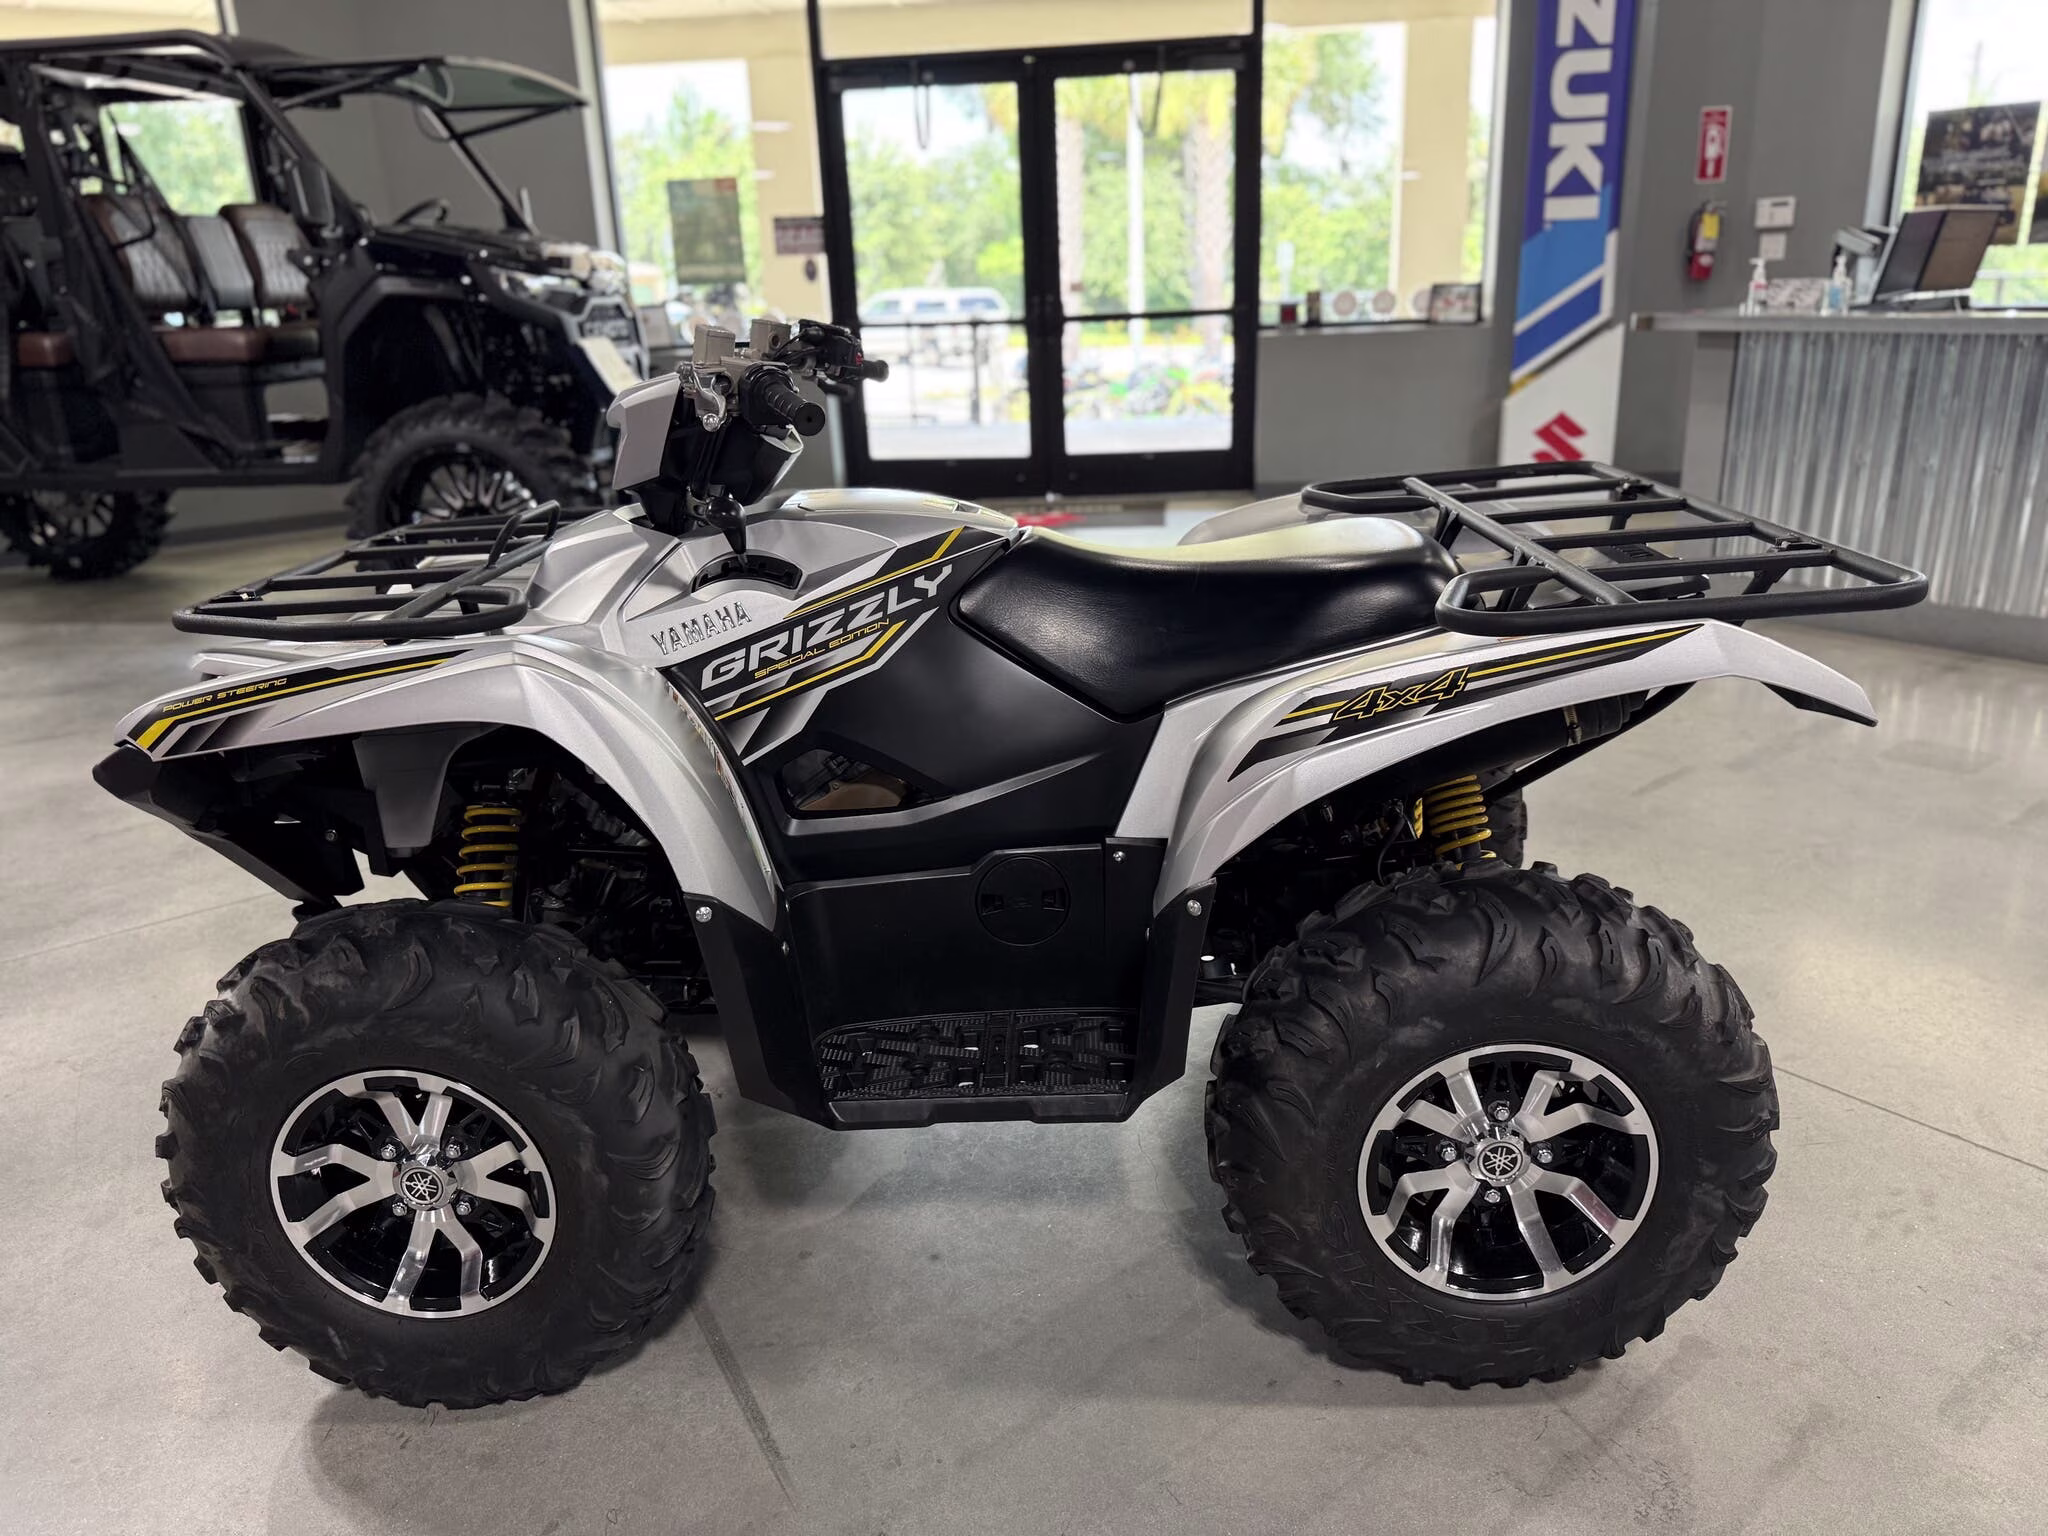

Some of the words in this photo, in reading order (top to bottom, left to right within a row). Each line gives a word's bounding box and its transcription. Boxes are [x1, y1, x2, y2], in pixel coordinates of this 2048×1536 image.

[650, 601, 753, 656] YAMAHA
[700, 563, 953, 691] GRIZZLY
[754, 648, 826, 680] SPECIAL
[829, 618, 891, 648] EDITION
[163, 695, 213, 712] POWER
[217, 678, 287, 699] STEERING
[1333, 666, 1469, 721] 4x4
